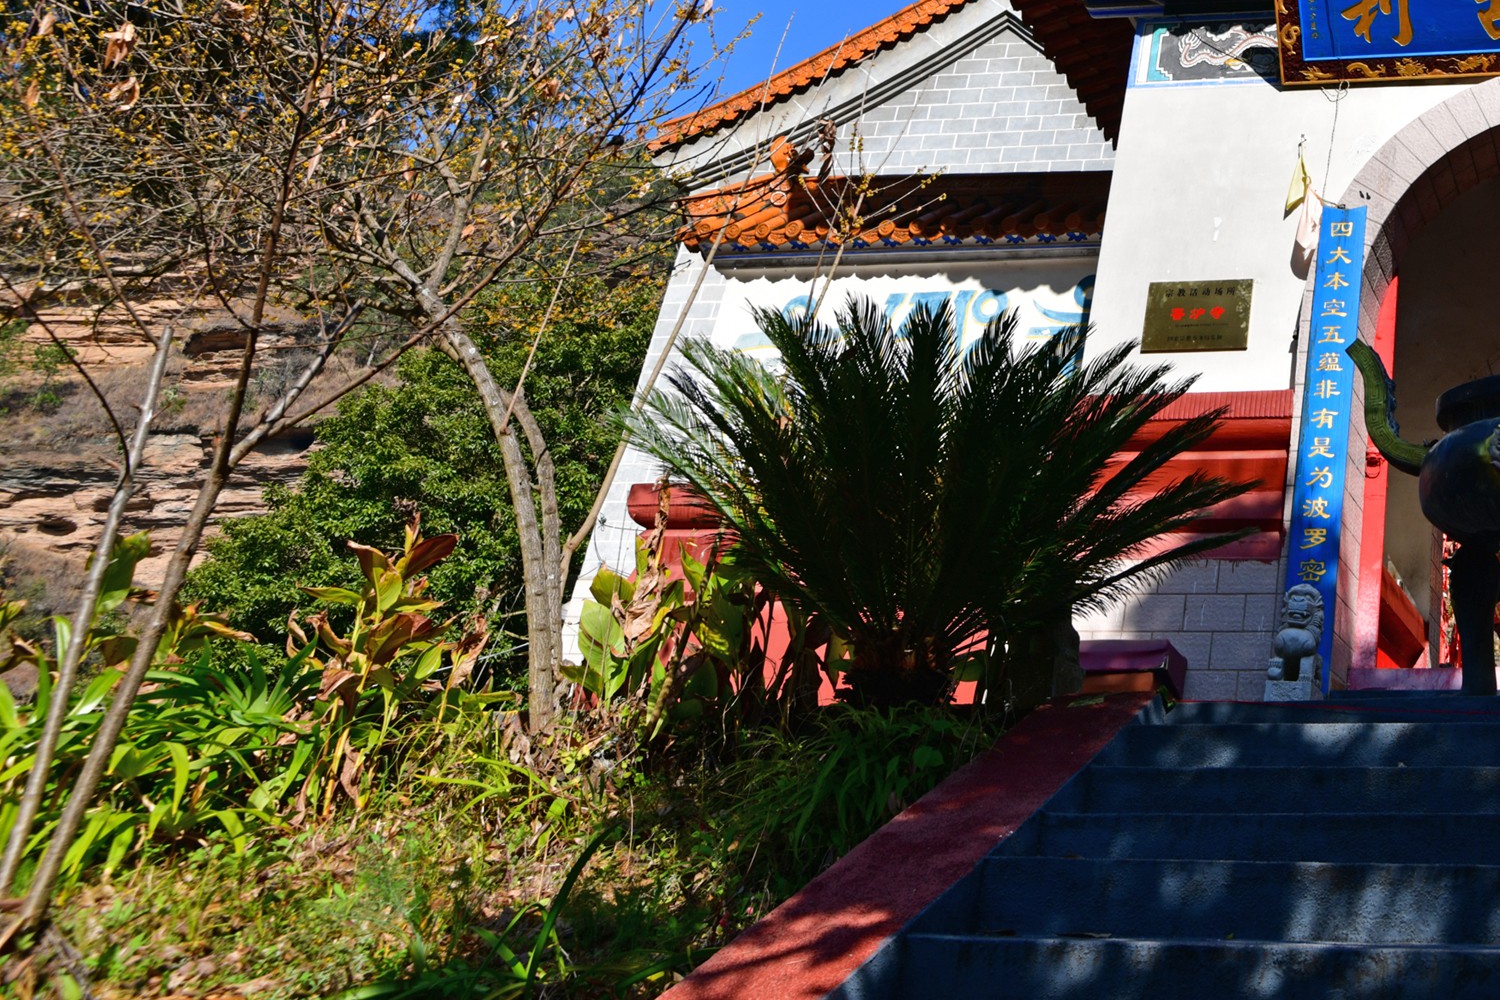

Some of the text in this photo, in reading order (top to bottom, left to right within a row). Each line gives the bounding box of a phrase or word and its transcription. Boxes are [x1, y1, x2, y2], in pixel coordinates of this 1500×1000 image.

[1165, 287, 1236, 298] 宗教活动场所
